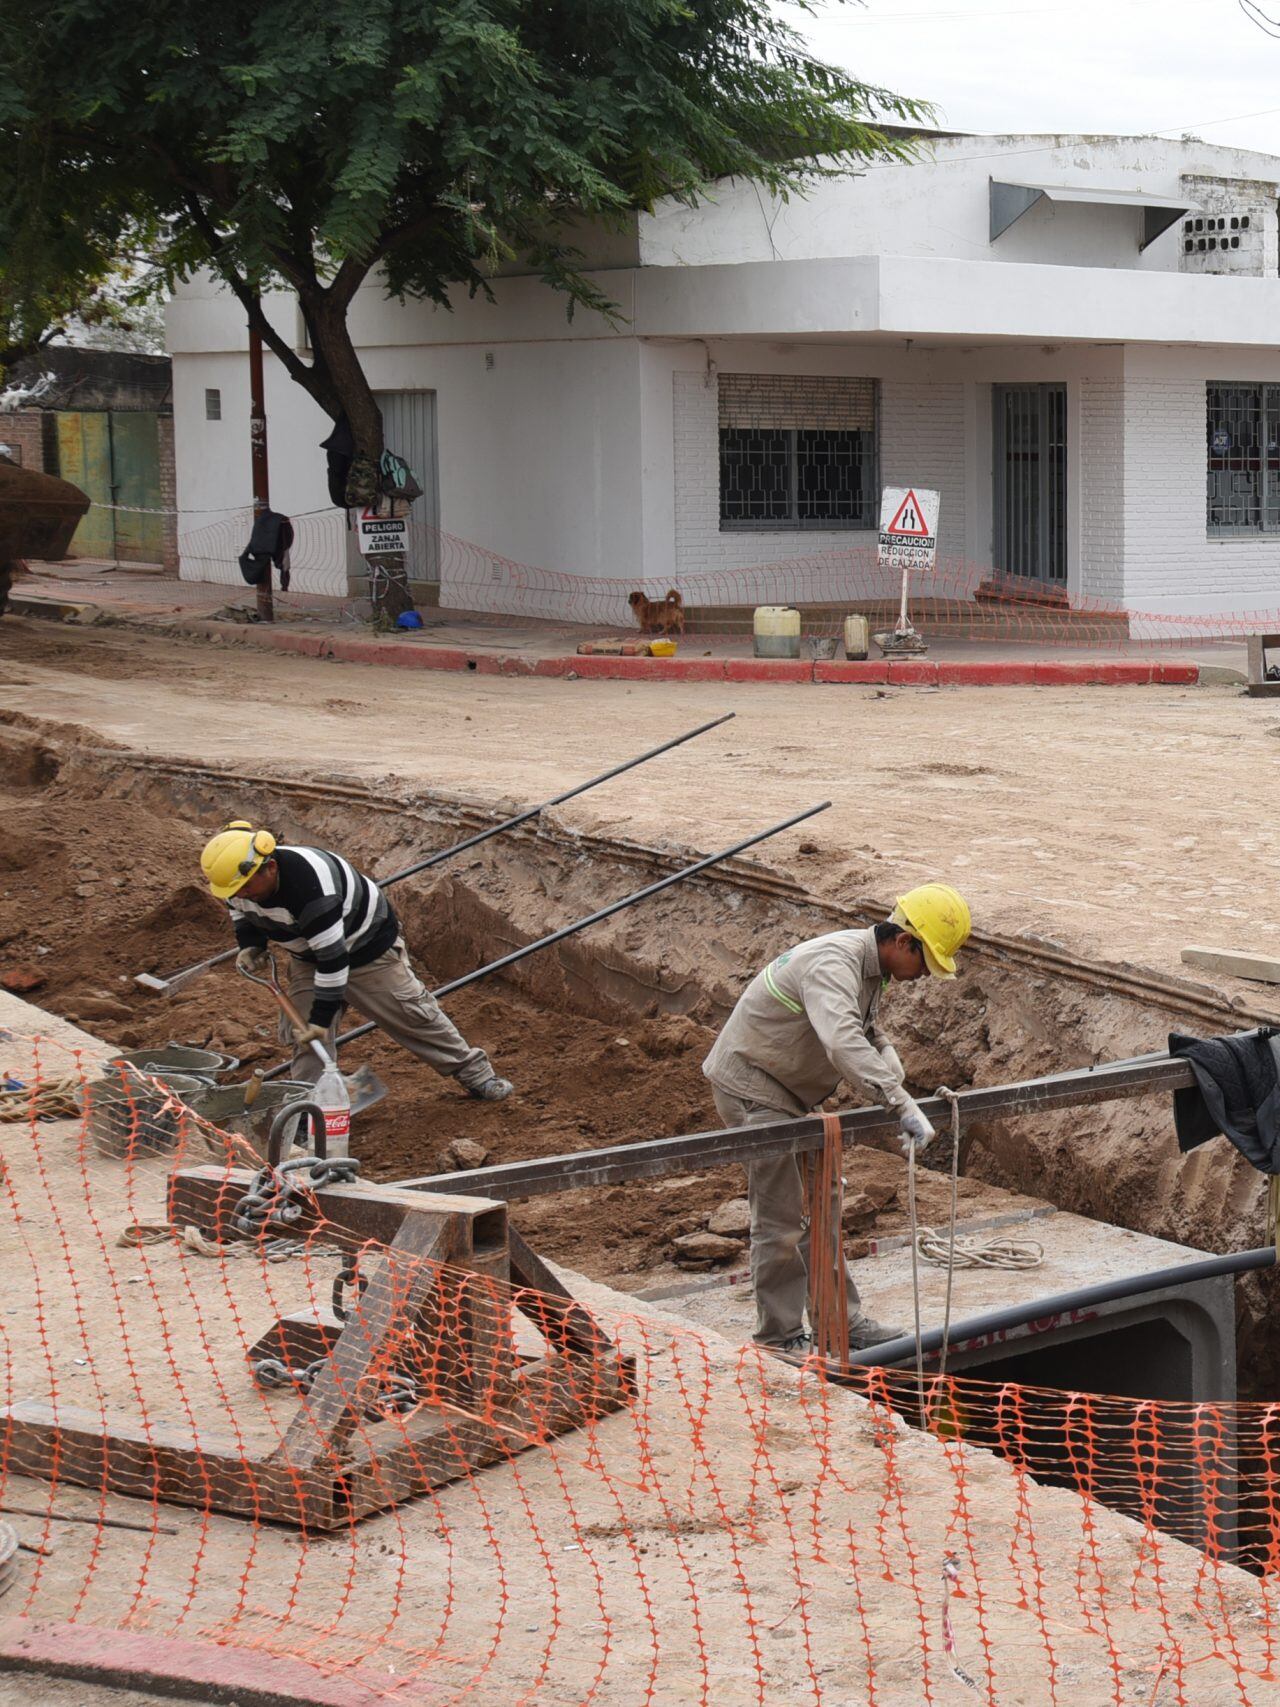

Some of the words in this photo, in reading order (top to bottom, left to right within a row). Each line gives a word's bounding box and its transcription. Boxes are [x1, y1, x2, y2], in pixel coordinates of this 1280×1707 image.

[365, 523, 403, 531] PELIGRO
[371, 534, 400, 543] ZANJA
[880, 534, 934, 547] PRECAUCION
[368, 542, 405, 551] ABIERTA
[881, 547, 930, 558] REDUCCION
[878, 557, 890, 566] DE
[891, 559, 930, 569] CALZADA
